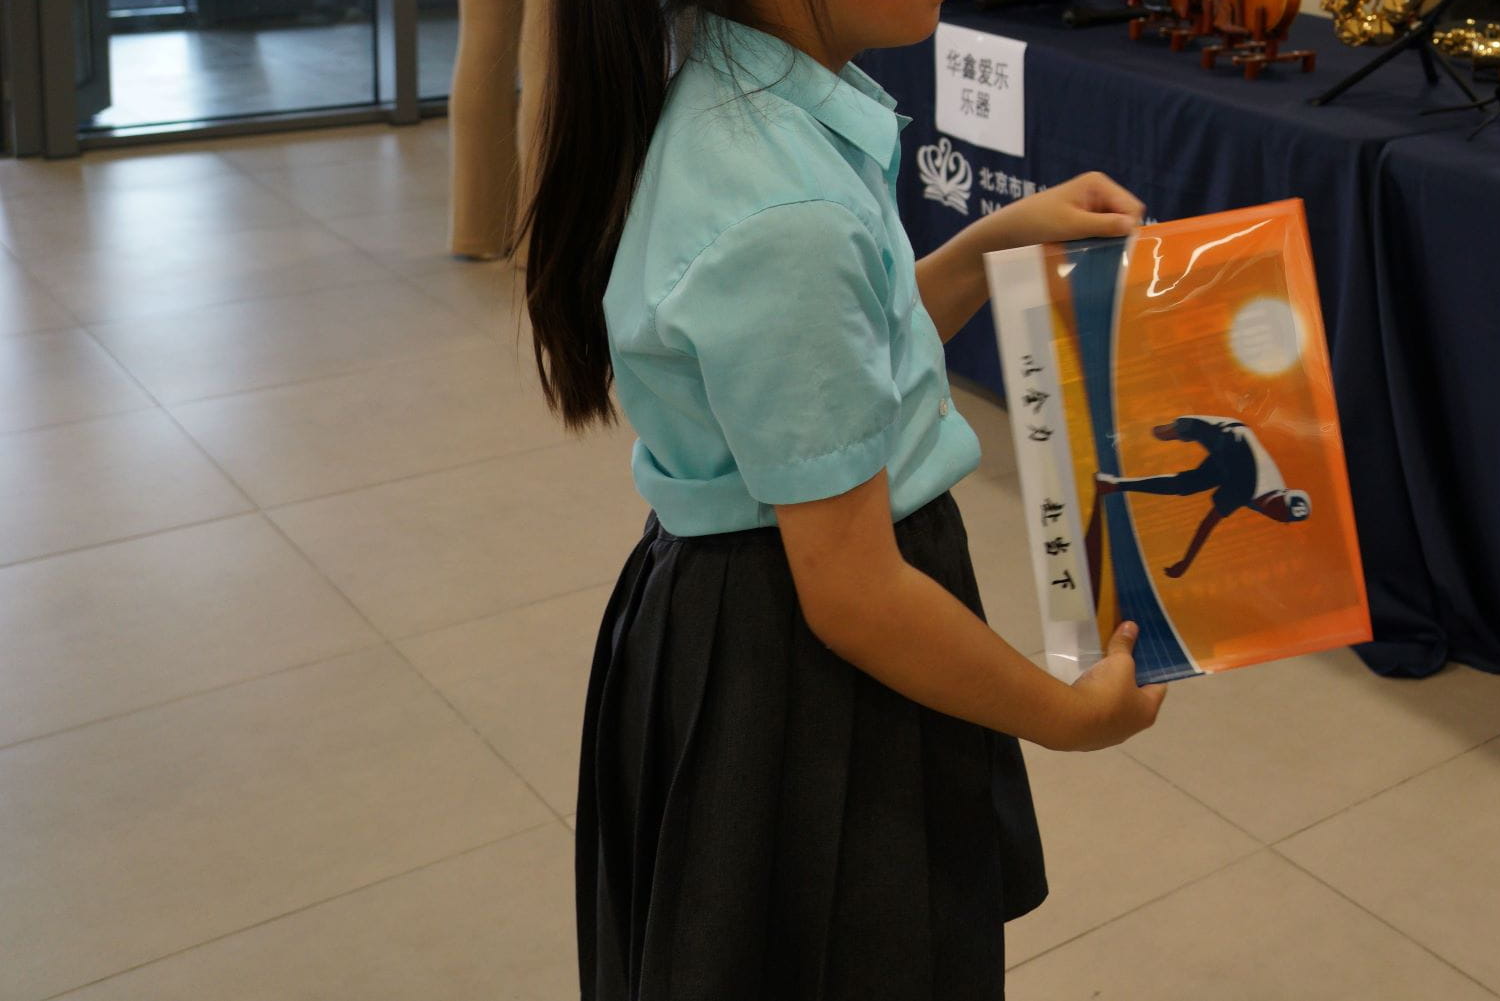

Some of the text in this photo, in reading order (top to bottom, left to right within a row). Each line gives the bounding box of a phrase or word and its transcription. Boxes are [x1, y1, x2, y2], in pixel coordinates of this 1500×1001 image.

[946, 48, 1009, 91] 华鑫爱乐
[960, 88, 990, 119] 乐器
